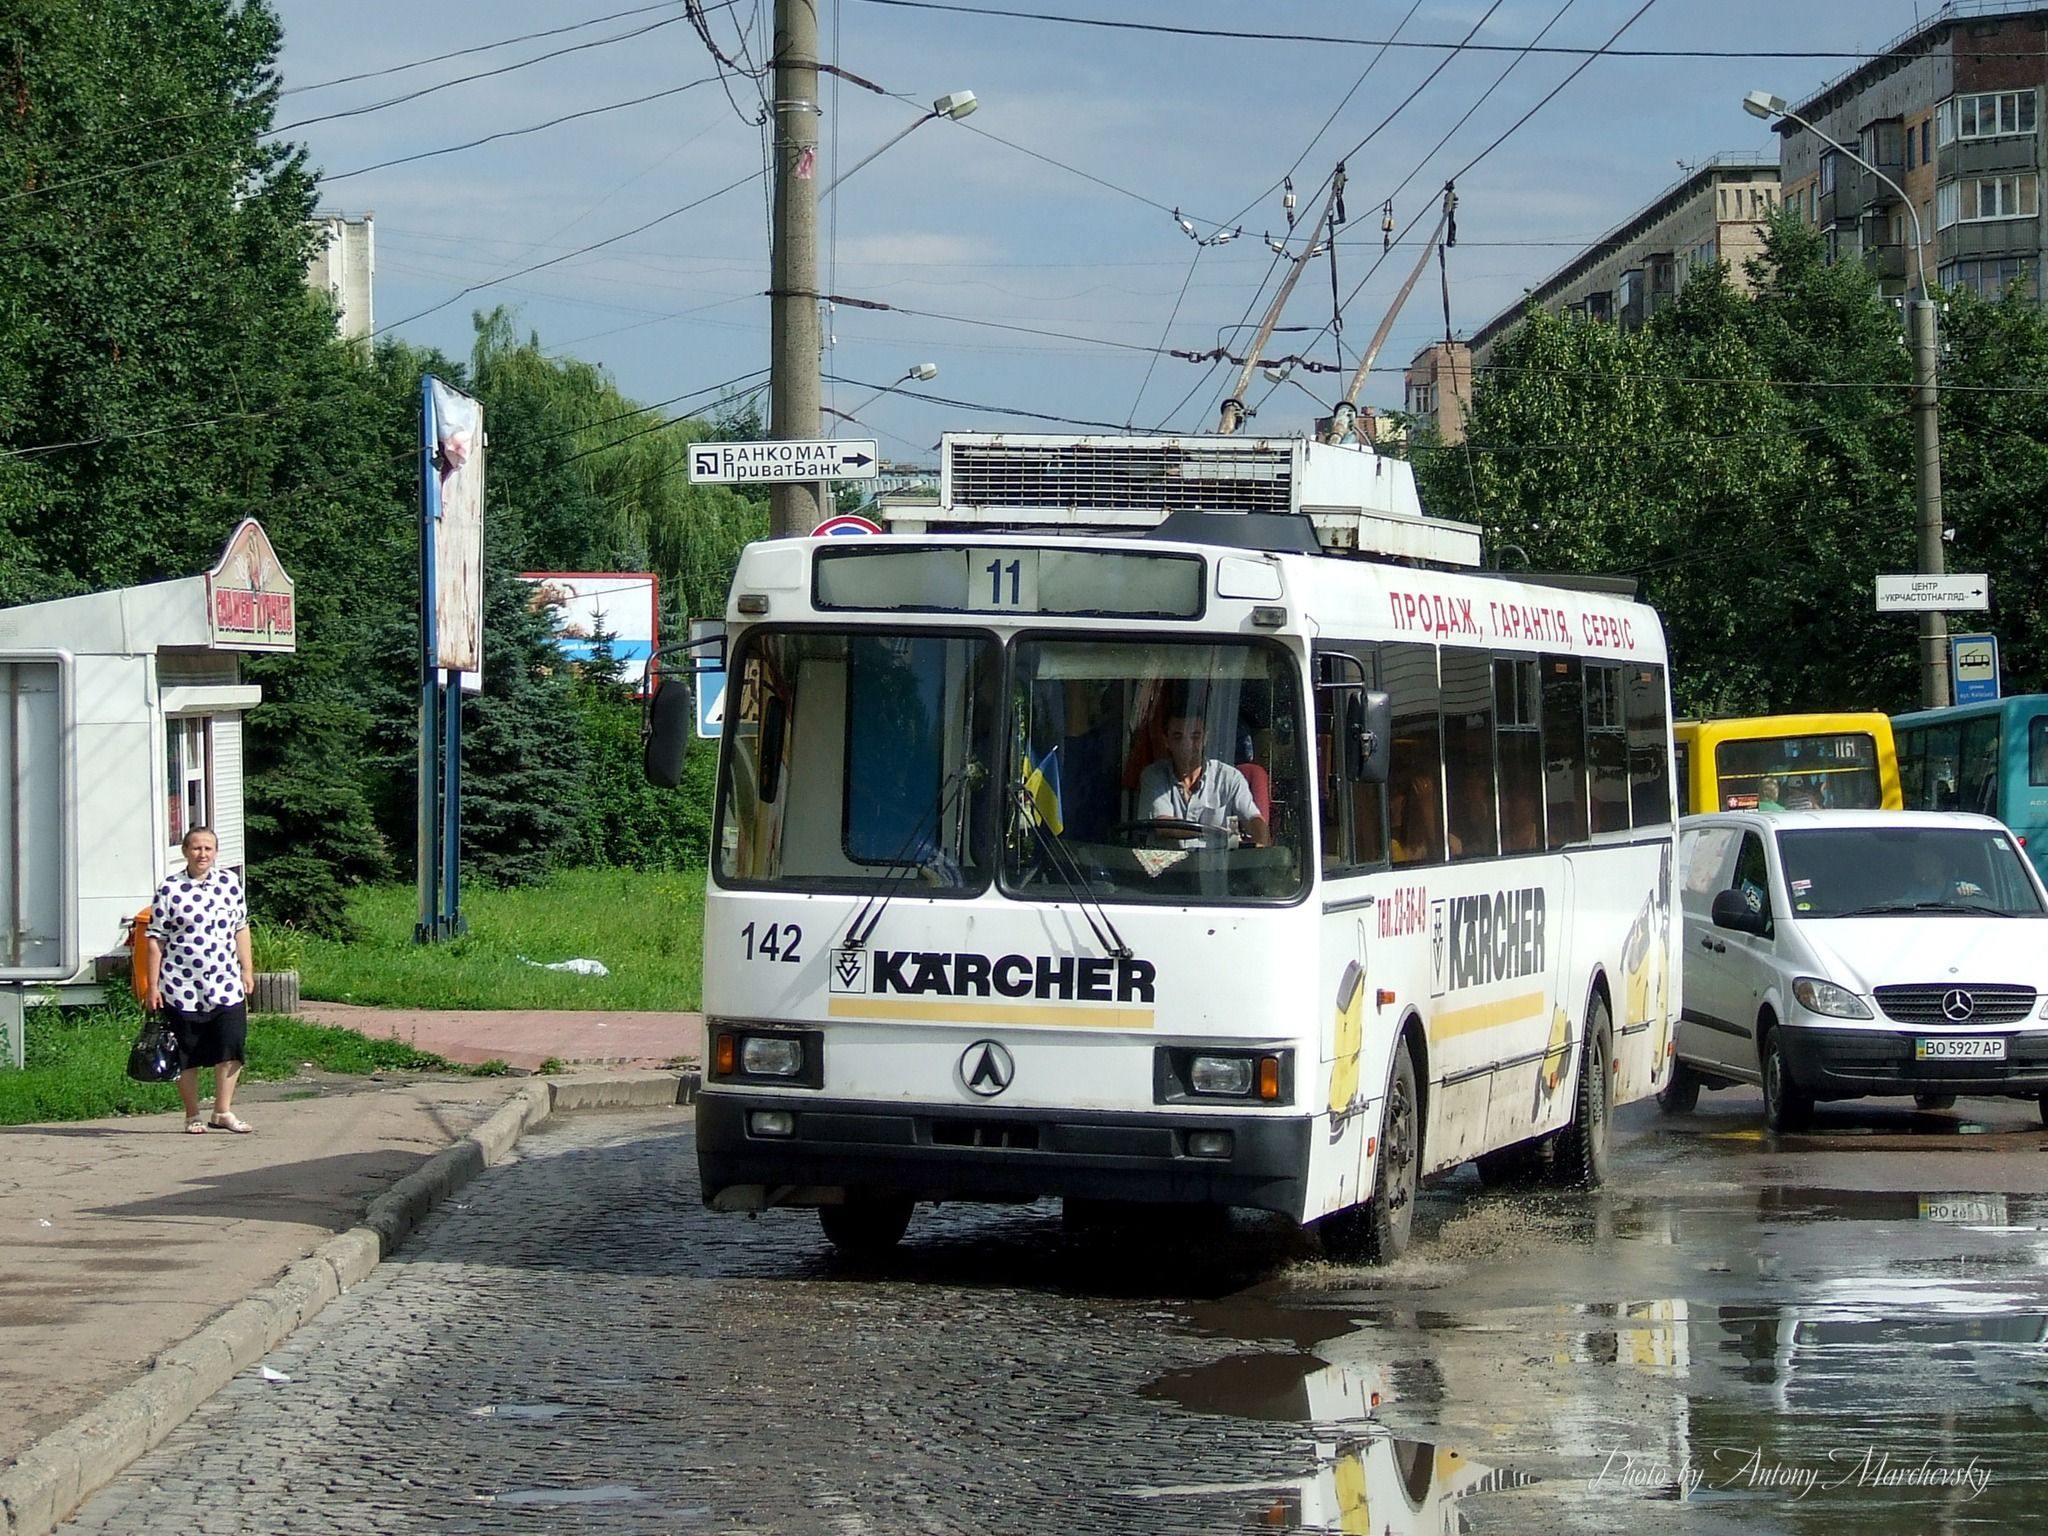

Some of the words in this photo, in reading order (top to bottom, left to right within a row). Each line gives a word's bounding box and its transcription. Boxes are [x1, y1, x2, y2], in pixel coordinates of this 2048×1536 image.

[723, 445, 838, 462] БАНКОМАТ
[723, 461, 841, 481] ПриватБанк
[986, 559, 1020, 605] 11
[1911, 582, 1938, 592] ЦЕНТР
[1389, 592, 1484, 643] ПРОДАЖ,
[1490, 602, 1573, 650] ГАРАНТІЯ,
[1582, 613, 1635, 650] СЕРВІС
[740, 921, 802, 963] 142
[1449, 887, 1546, 991] KÄRCHER
[872, 950, 1156, 1003] KÄRCHER
[1949, 1041, 1980, 1055] 5927
[1982, 1041, 2002, 1055] AP
